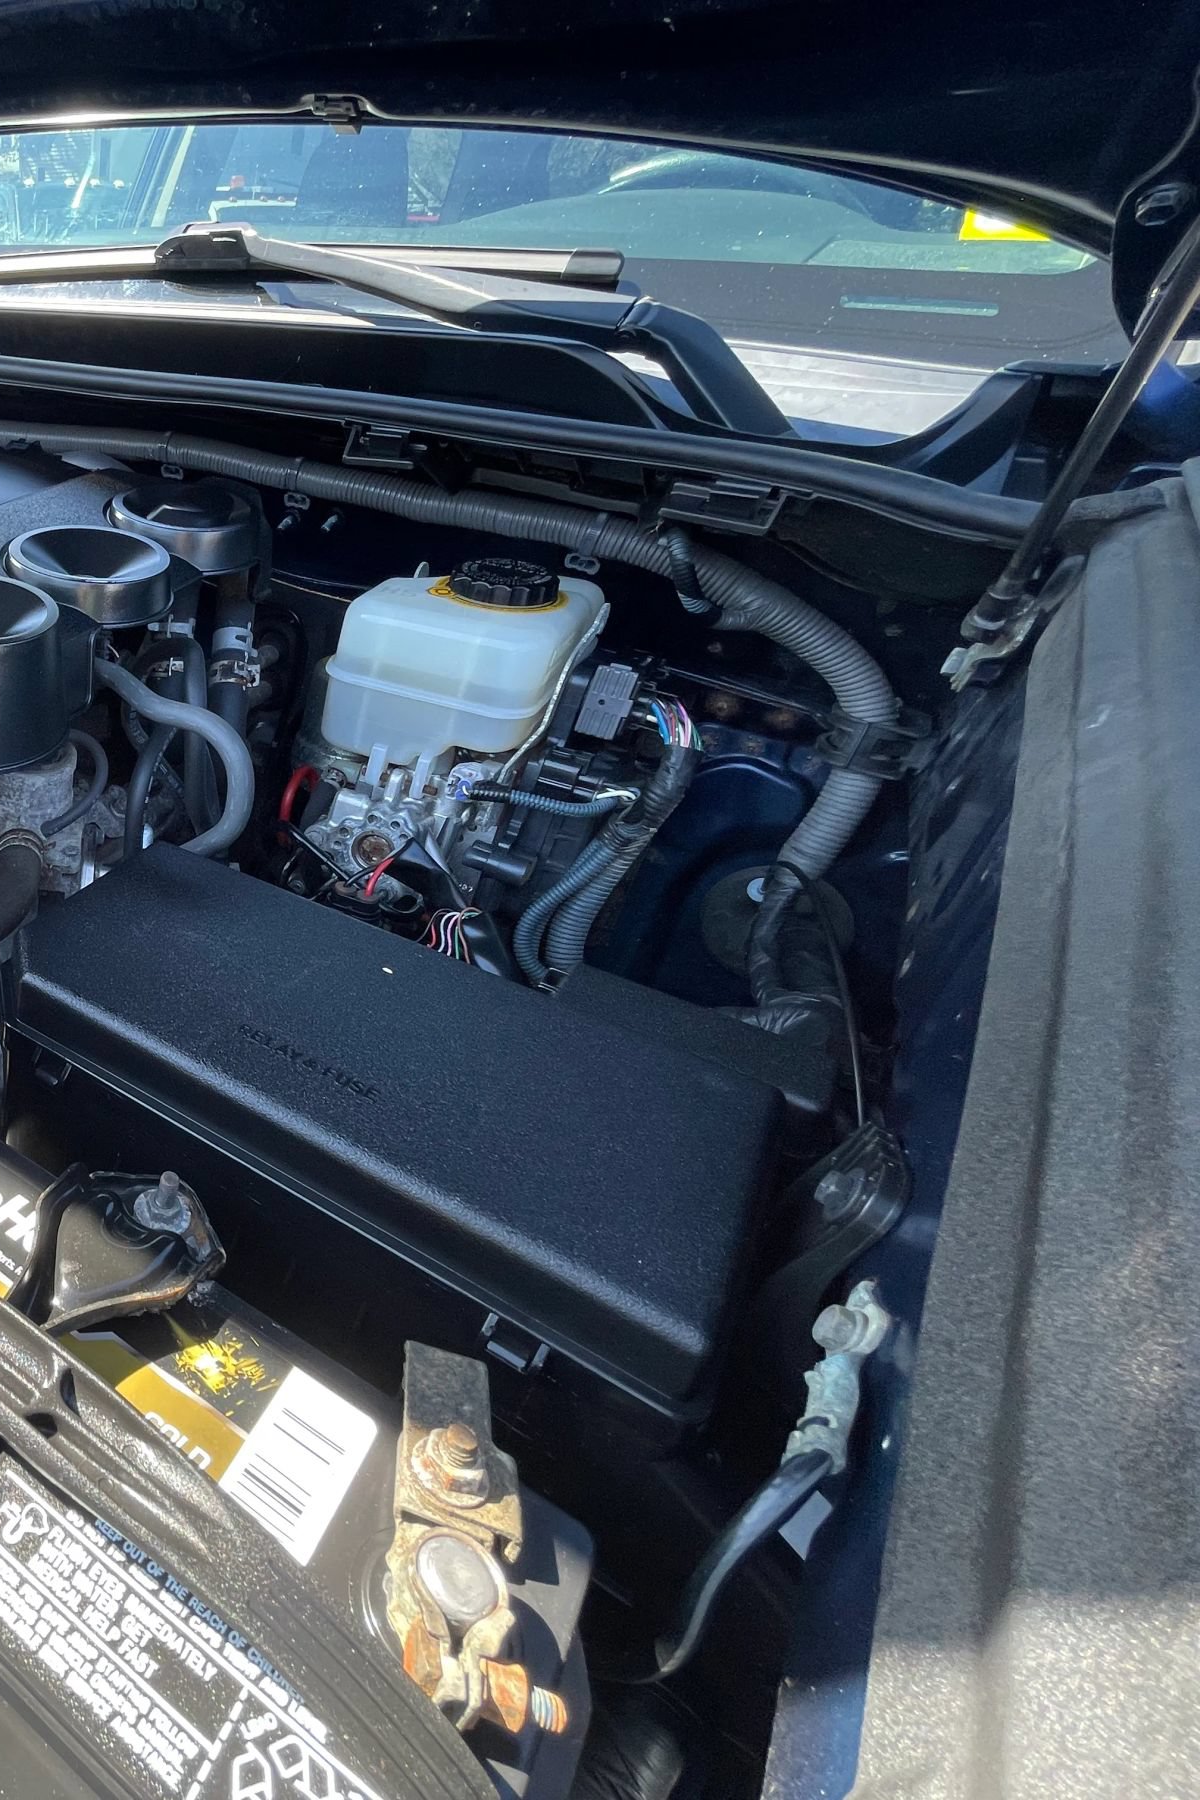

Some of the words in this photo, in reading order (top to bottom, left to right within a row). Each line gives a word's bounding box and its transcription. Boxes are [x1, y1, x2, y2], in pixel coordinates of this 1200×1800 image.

[25, 1554, 81, 1612] MEDICAL
[82, 1604, 121, 1641] HELP
[118, 1638, 159, 1678] FAST
[39, 1539, 74, 1577] WITH
[121, 1614, 153, 1647] GET
[47, 1525, 92, 1569] FLUSH
[88, 1561, 126, 1604] EYES
[124, 1594, 217, 1681] IMMEDIATELY
[95, 1517, 124, 1541] KEEP
[123, 1539, 147, 1563] OUT
[147, 1561, 165, 1576] OF
[165, 1575, 188, 1600] THE
[188, 1596, 227, 1634] REACH
[228, 1631, 247, 1648] OF
[189, 1615, 222, 1648] CAPS
[148, 1707, 199, 1759] FOLLOW
